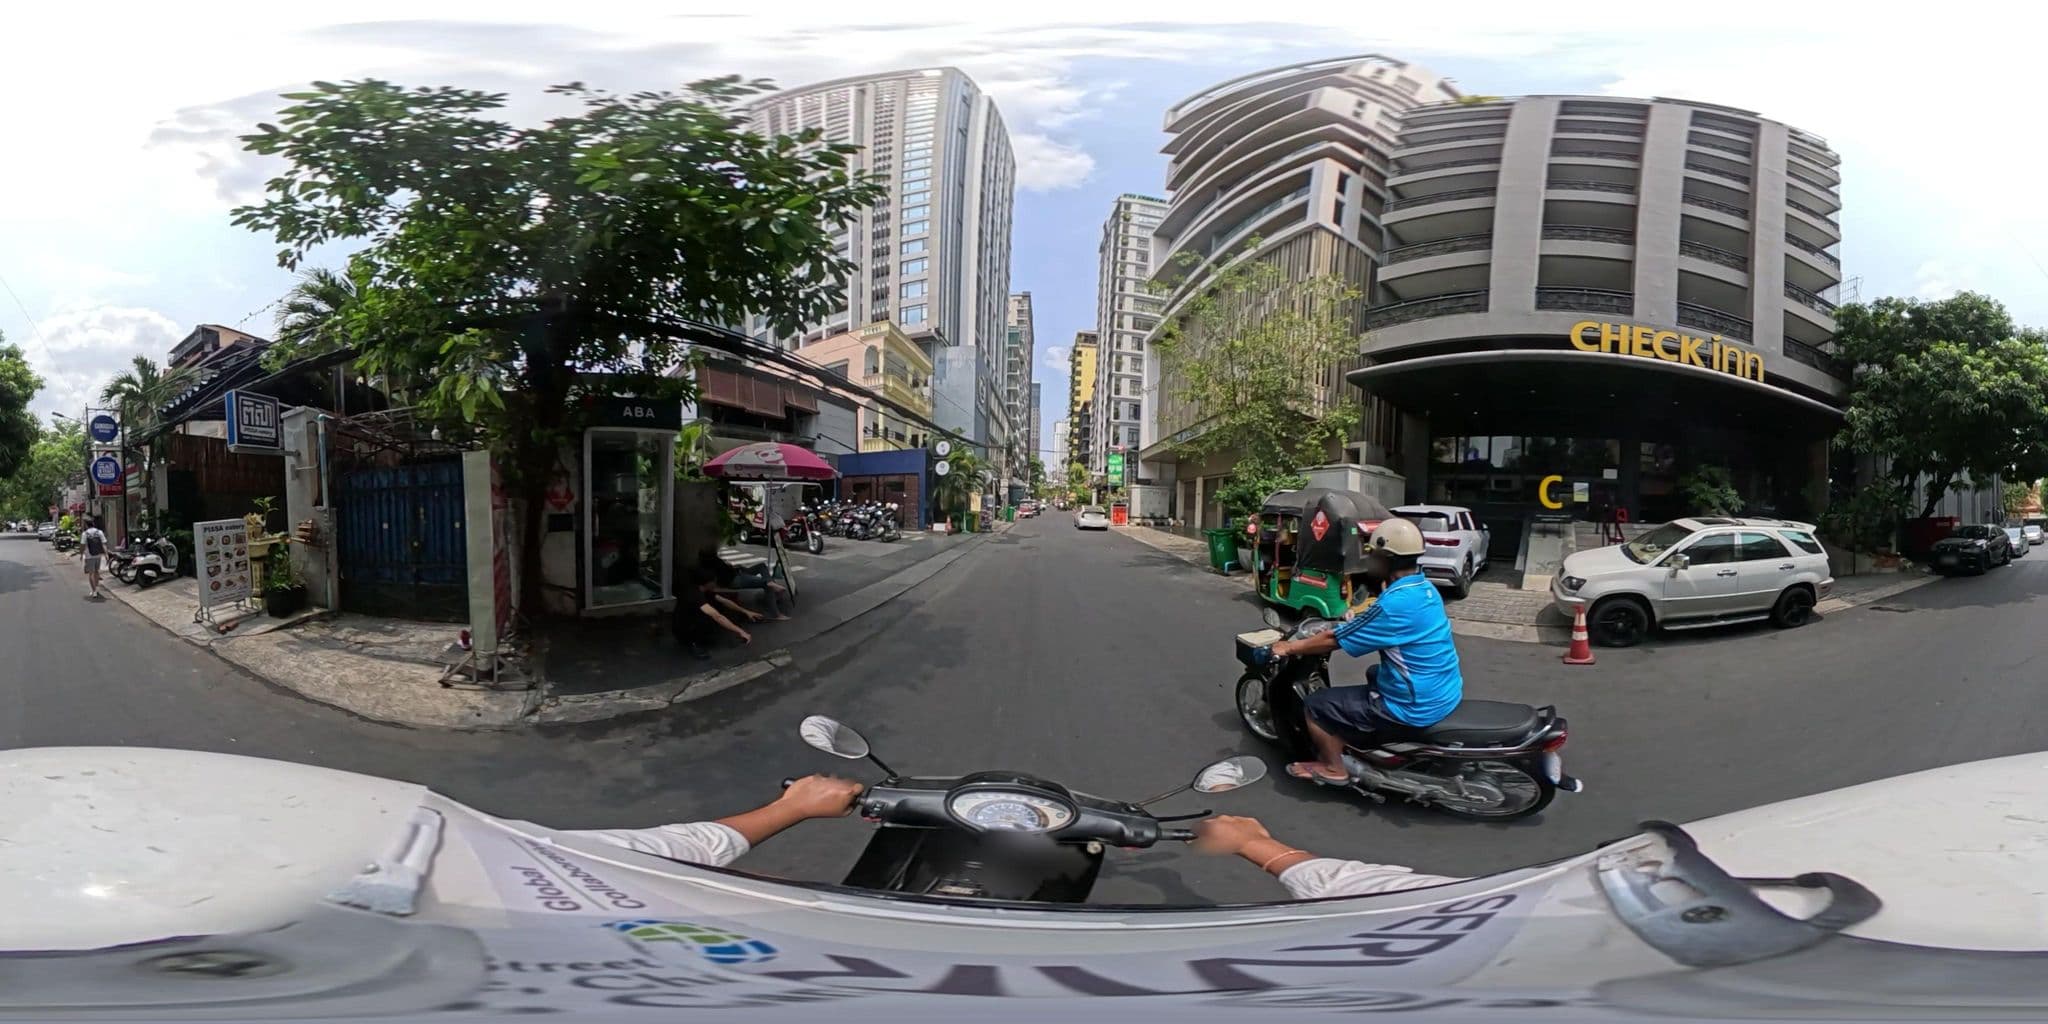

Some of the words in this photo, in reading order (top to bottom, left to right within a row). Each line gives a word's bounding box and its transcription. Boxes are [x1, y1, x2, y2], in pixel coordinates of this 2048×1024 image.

[1570, 320, 1705, 368] CHECK
[1711, 335, 1764, 382] inn
[623, 406, 655, 418] ABA
[1538, 474, 1563, 510] C
[511, 865, 582, 912] Global
[757, 893, 1517, 997] SERVIR
